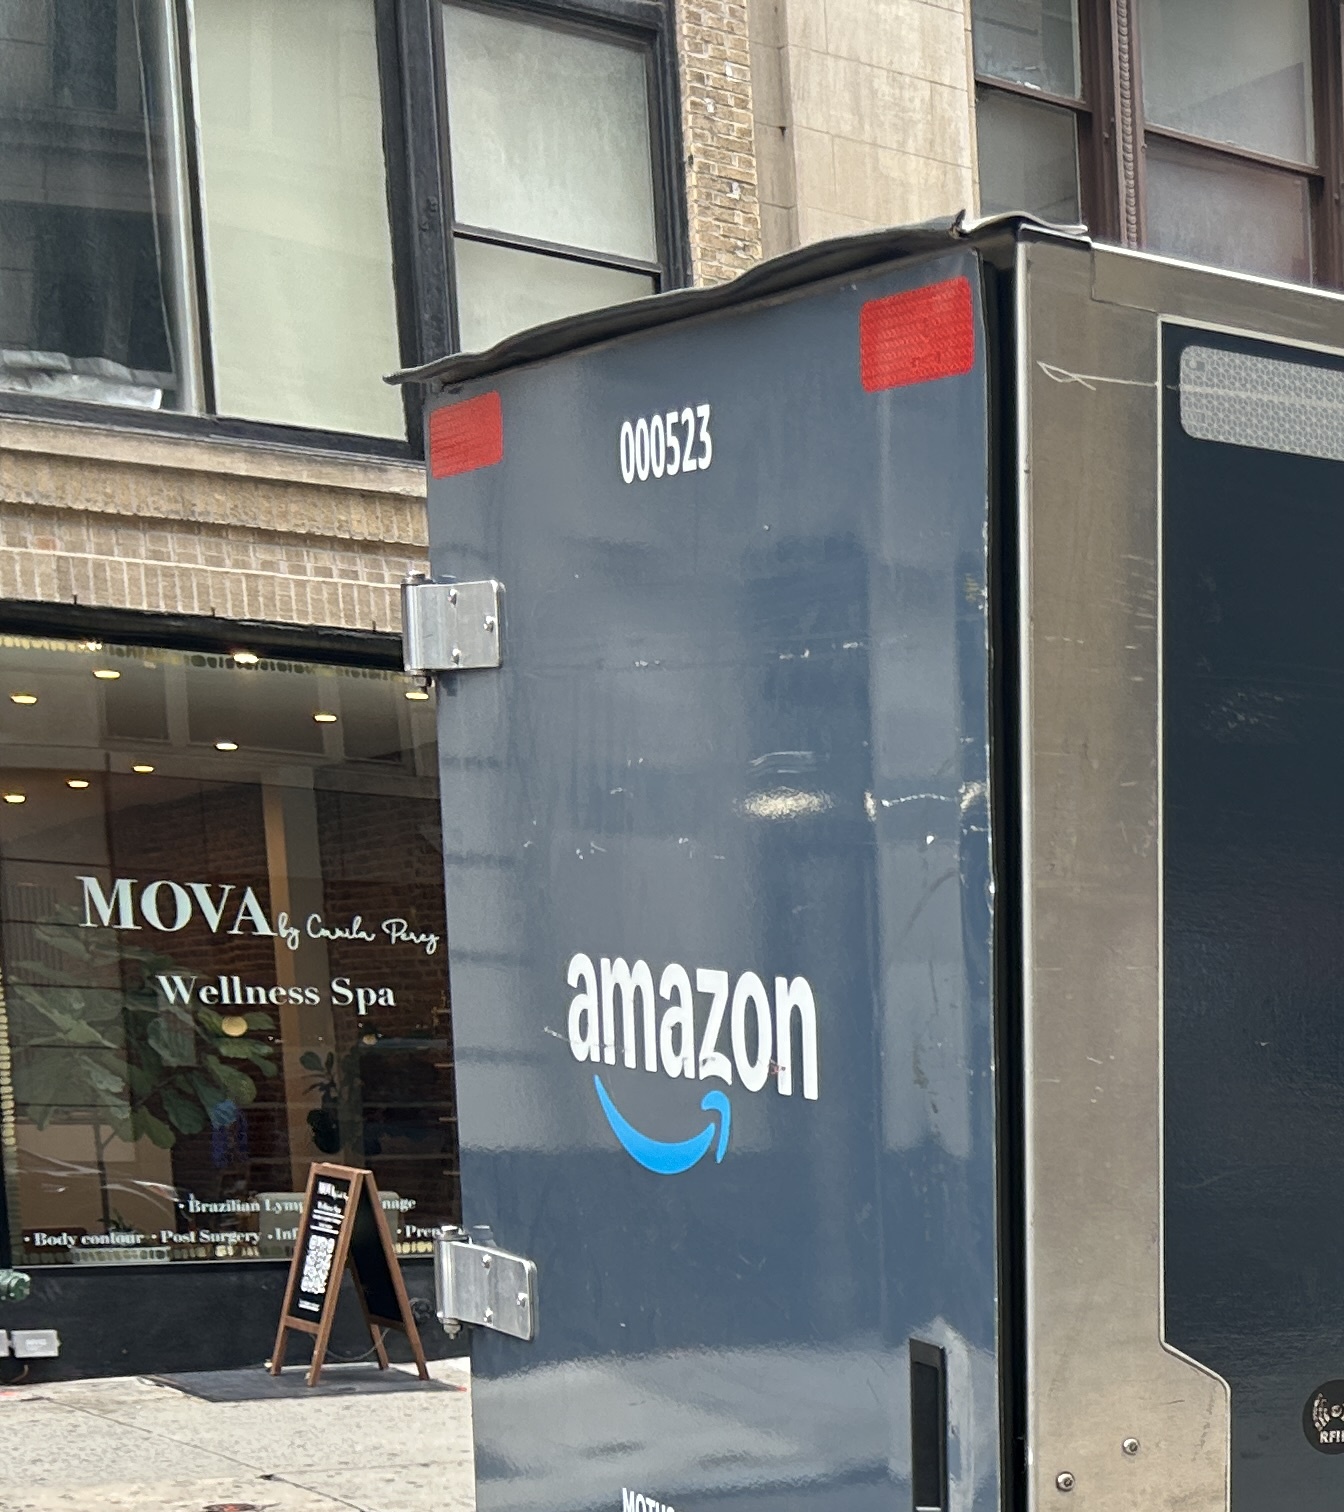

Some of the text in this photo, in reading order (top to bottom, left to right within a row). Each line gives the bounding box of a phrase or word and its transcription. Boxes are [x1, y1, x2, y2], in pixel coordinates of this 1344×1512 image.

[620, 403, 713, 484] 000523
[75, 875, 277, 937] MOVA
[277, 911, 300, 950] by
[155, 975, 397, 1016] Wellness Spa
[567, 952, 819, 1100] amazon
[188, 1197, 260, 1214] Brazilian
[33, 1232, 78, 1249] Body
[80, 1232, 145, 1246] contour
[160, 1231, 196, 1244] Post
[199, 1229, 261, 1246] Surgery
